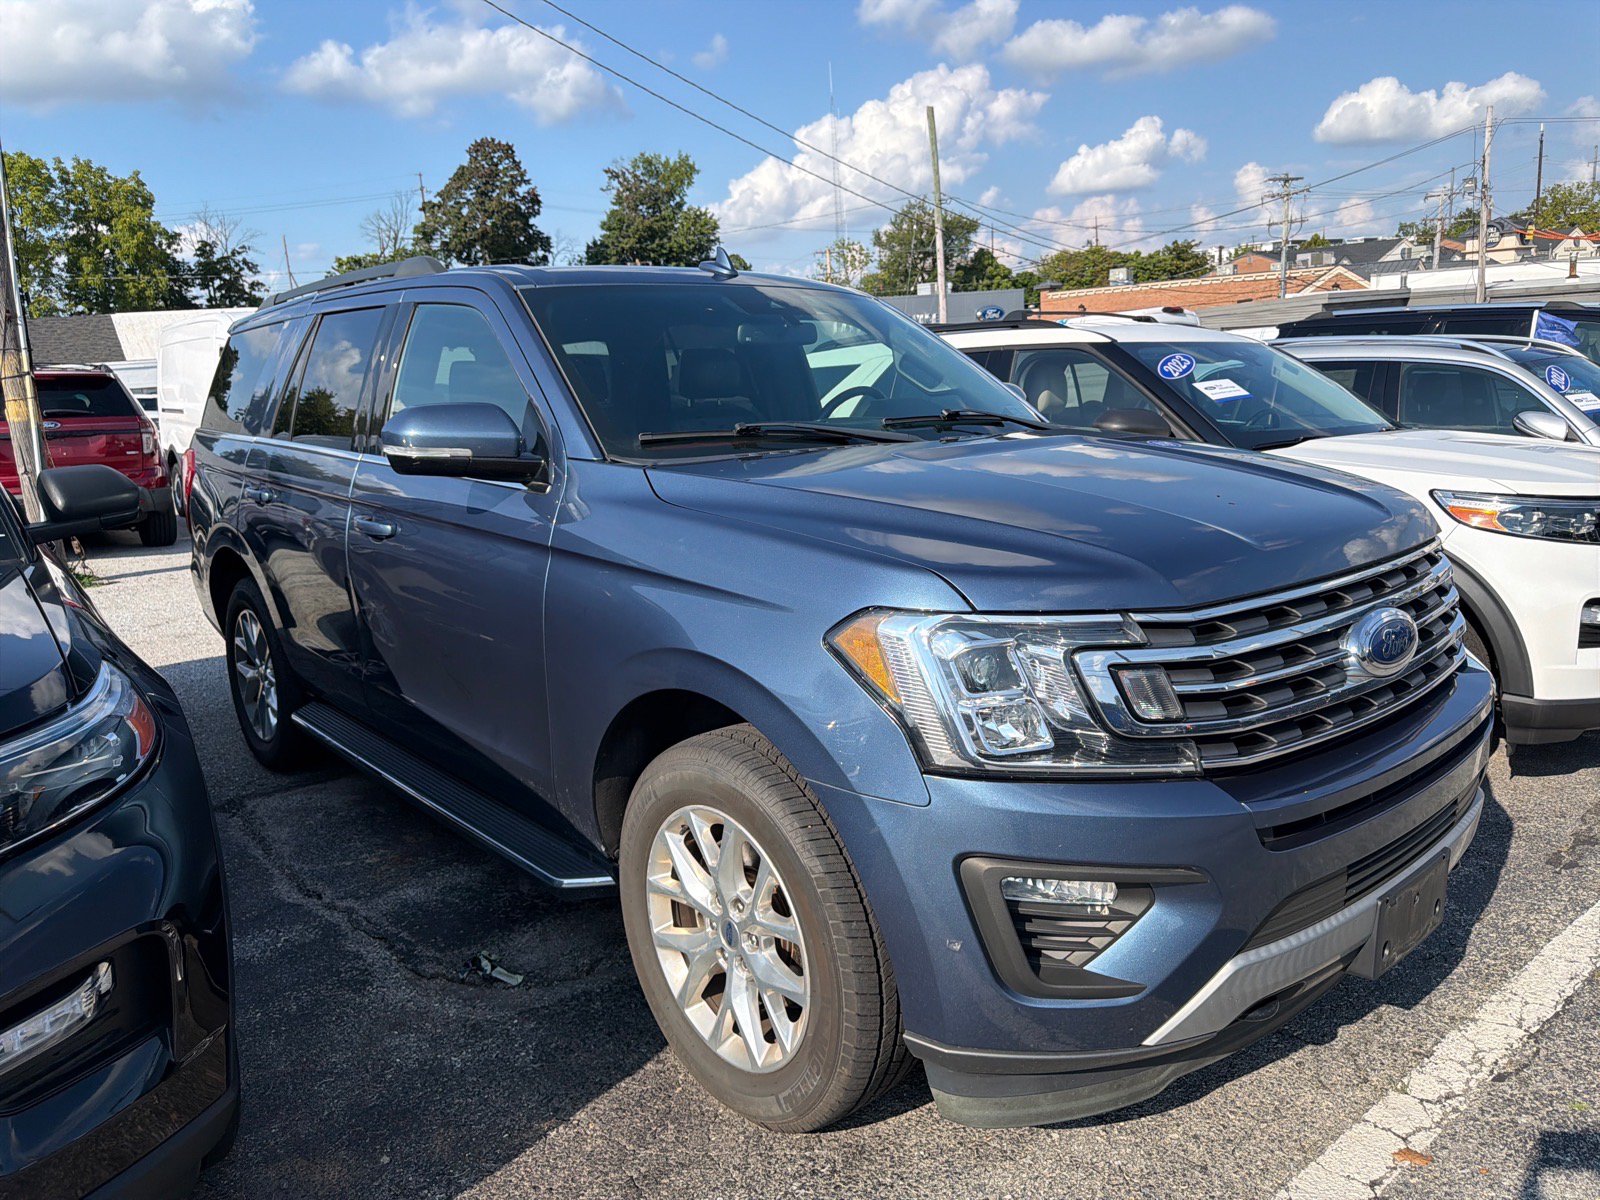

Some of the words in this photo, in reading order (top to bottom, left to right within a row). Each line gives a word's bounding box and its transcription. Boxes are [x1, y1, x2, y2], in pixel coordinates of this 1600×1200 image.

[985, 309, 1001, 319] Ford
[1163, 355, 1190, 376] 2023
[1551, 367, 1565, 390] 2021
[1382, 625, 1411, 658] Ford
